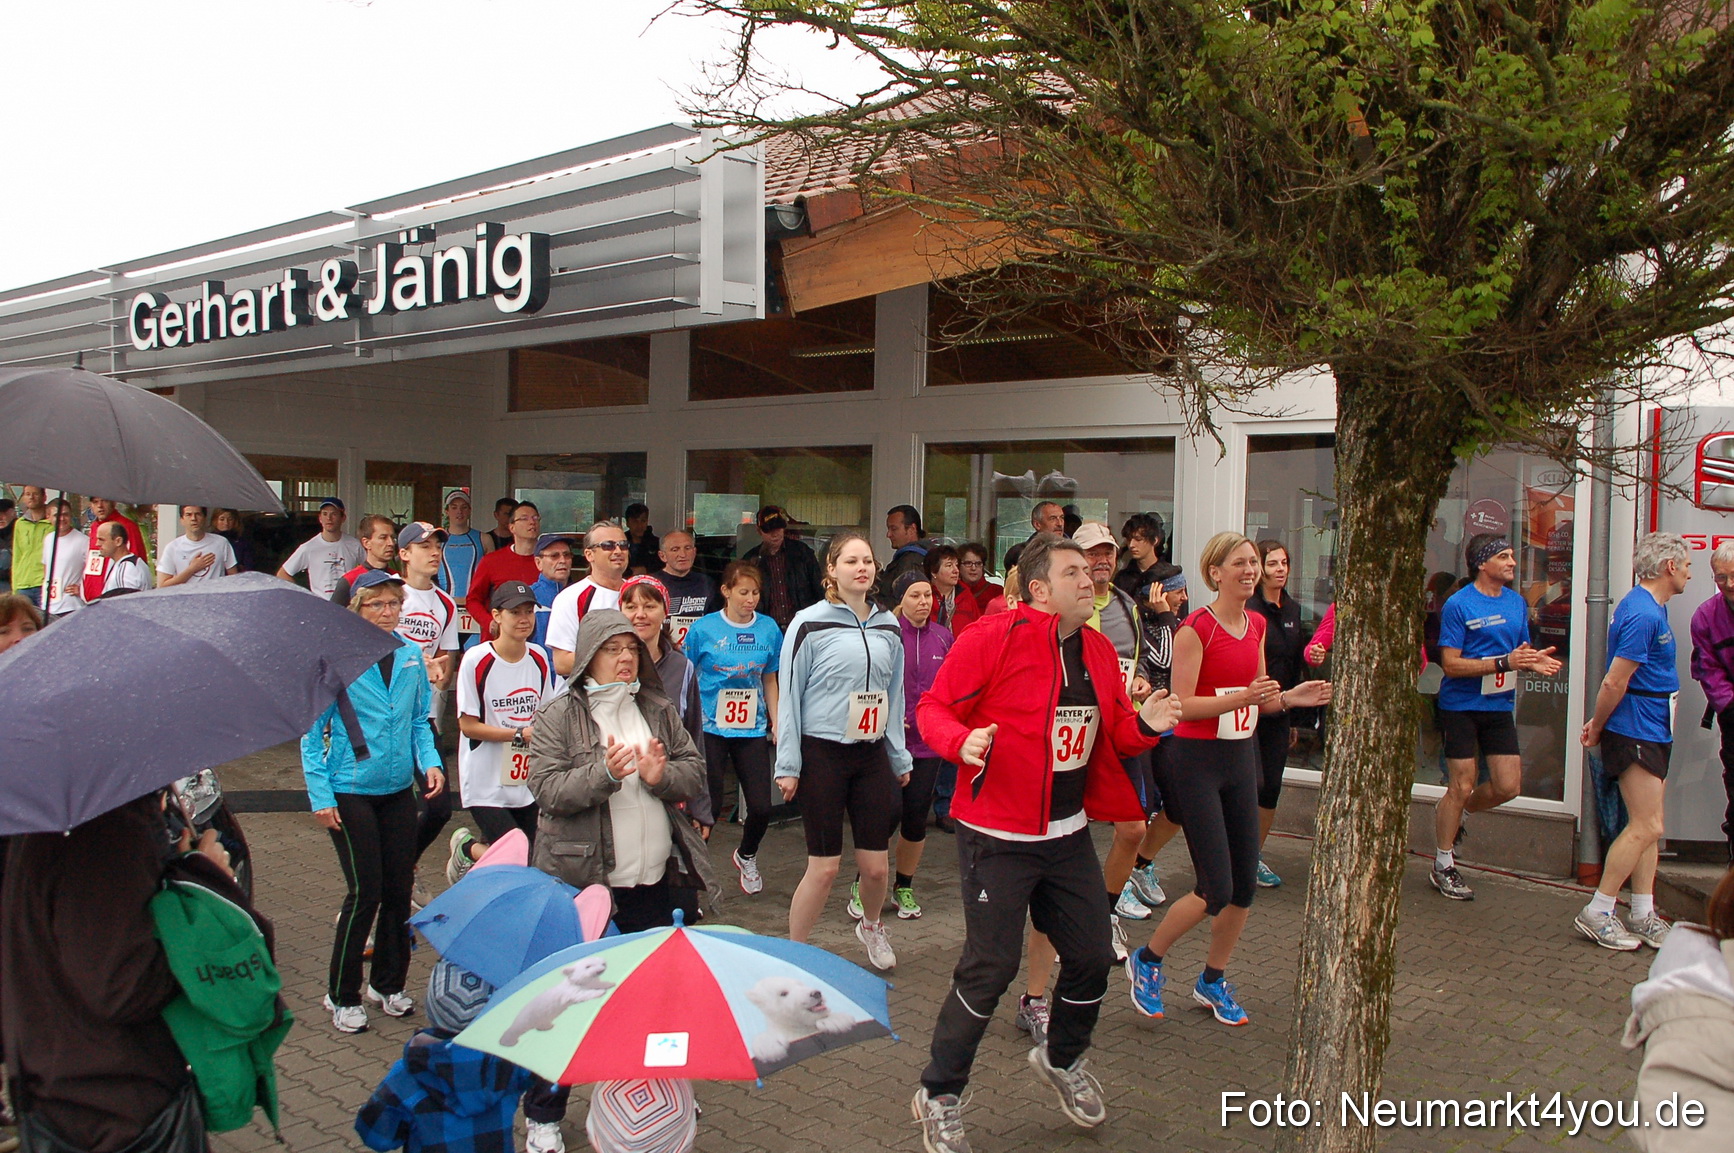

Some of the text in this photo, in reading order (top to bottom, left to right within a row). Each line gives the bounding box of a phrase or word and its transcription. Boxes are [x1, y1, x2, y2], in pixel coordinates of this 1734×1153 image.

[129, 221, 541, 351] Gerhart & Jänig
[681, 596, 707, 605] Wagner
[461, 616, 471, 629] 17
[1495, 670, 1505, 688] 9
[1525, 680, 1551, 693] DER
[725, 701, 748, 724] 35
[857, 707, 878, 734] 41
[1055, 709, 1082, 717] MEYER
[1233, 706, 1250, 732] 12
[1056, 725, 1087, 762] 34
